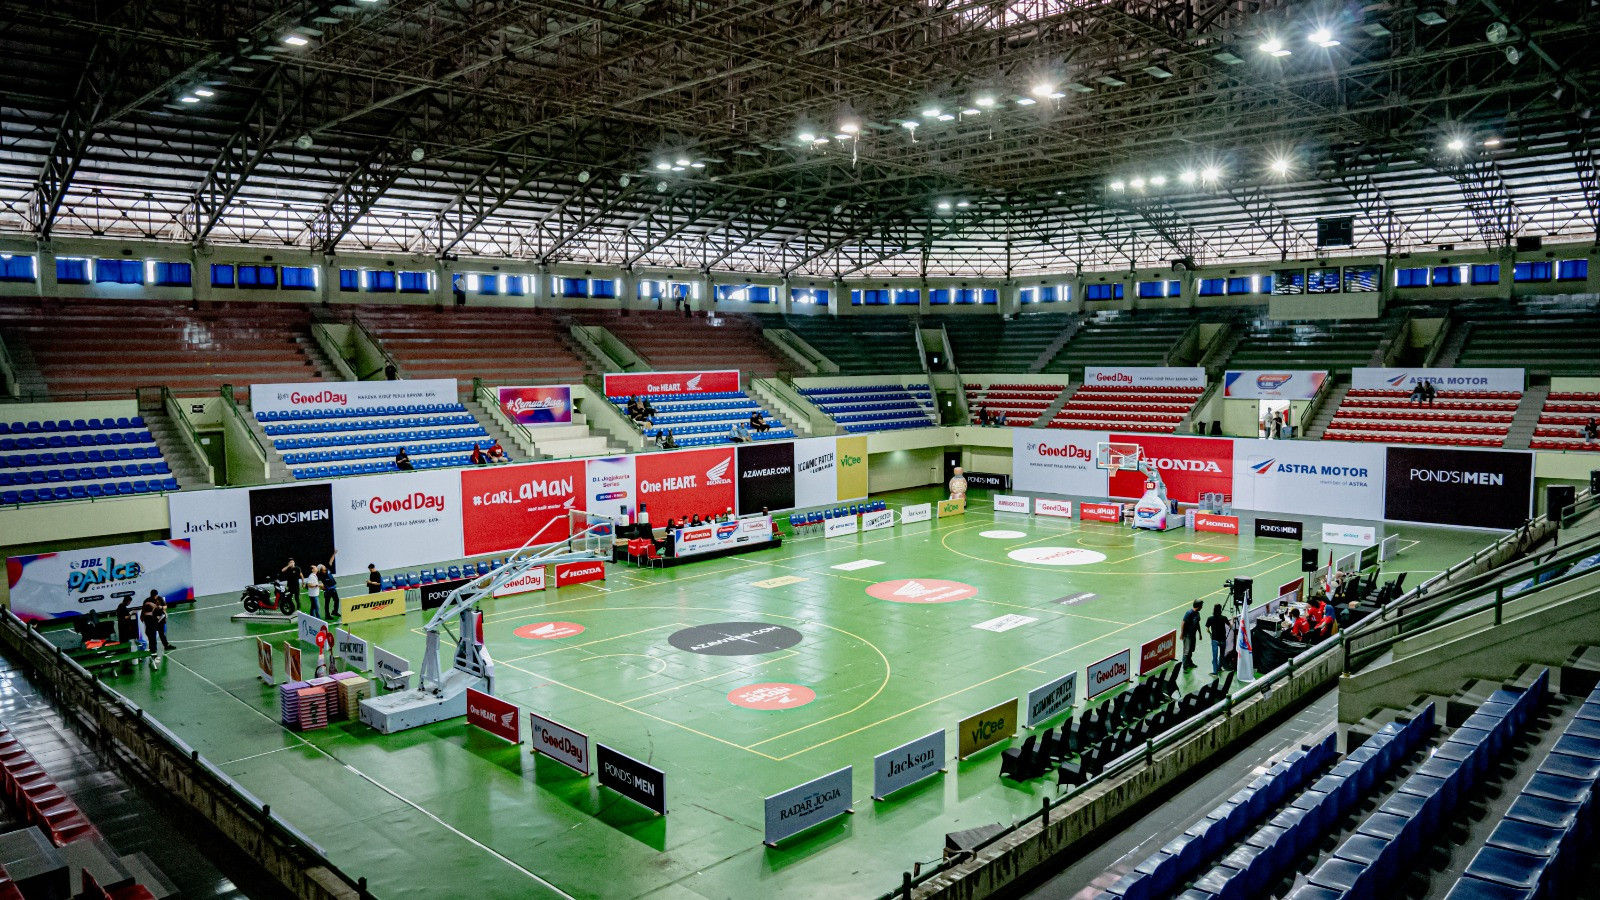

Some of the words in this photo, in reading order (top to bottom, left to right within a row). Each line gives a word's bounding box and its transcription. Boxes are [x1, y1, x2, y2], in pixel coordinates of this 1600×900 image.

[1096, 373, 1117, 382] Good
[1117, 373, 1133, 384] Day
[1409, 376, 1444, 386] ASTRA
[1447, 377, 1488, 386] MOTOR
[647, 383, 661, 393] One
[290, 391, 324, 406] Good
[324, 391, 348, 406] Day
[1038, 443, 1068, 457] Good
[1068, 444, 1092, 462] Day
[742, 465, 791, 480] AZAWEAR.COM
[1142, 457, 1223, 473] HONDA
[1277, 463, 1318, 475] ASTRA
[1320, 466, 1369, 478] MOTOR
[640, 479, 662, 494] One
[662, 475, 697, 491] HEART.
[706, 479, 732, 487] HONDA
[369, 494, 414, 515] Good
[413, 491, 446, 512] Day
[1041, 503, 1057, 512] Good
[1057, 504, 1069, 515] Day
[183, 518, 239, 535] Jackson
[1205, 519, 1236, 529] HONDA
[690, 531, 711, 541] HONDA
[80, 557, 103, 569] DBL
[68, 556, 137, 594] DANCE
[569, 566, 603, 578] HONDA
[91, 580, 137, 591] COMPETITION
[525, 574, 542, 587] Day
[350, 597, 395, 613] proteam
[1096, 665, 1114, 685] Good
[1114, 662, 1127, 677] Day
[469, 704, 480, 716] One
[541, 728, 564, 751] Good
[564, 739, 583, 765] Day
[887, 748, 935, 778] Jackson
[921, 761, 935, 771] SHOES
[779, 799, 813, 821] RADAR
[813, 788, 841, 807] JOGJA
